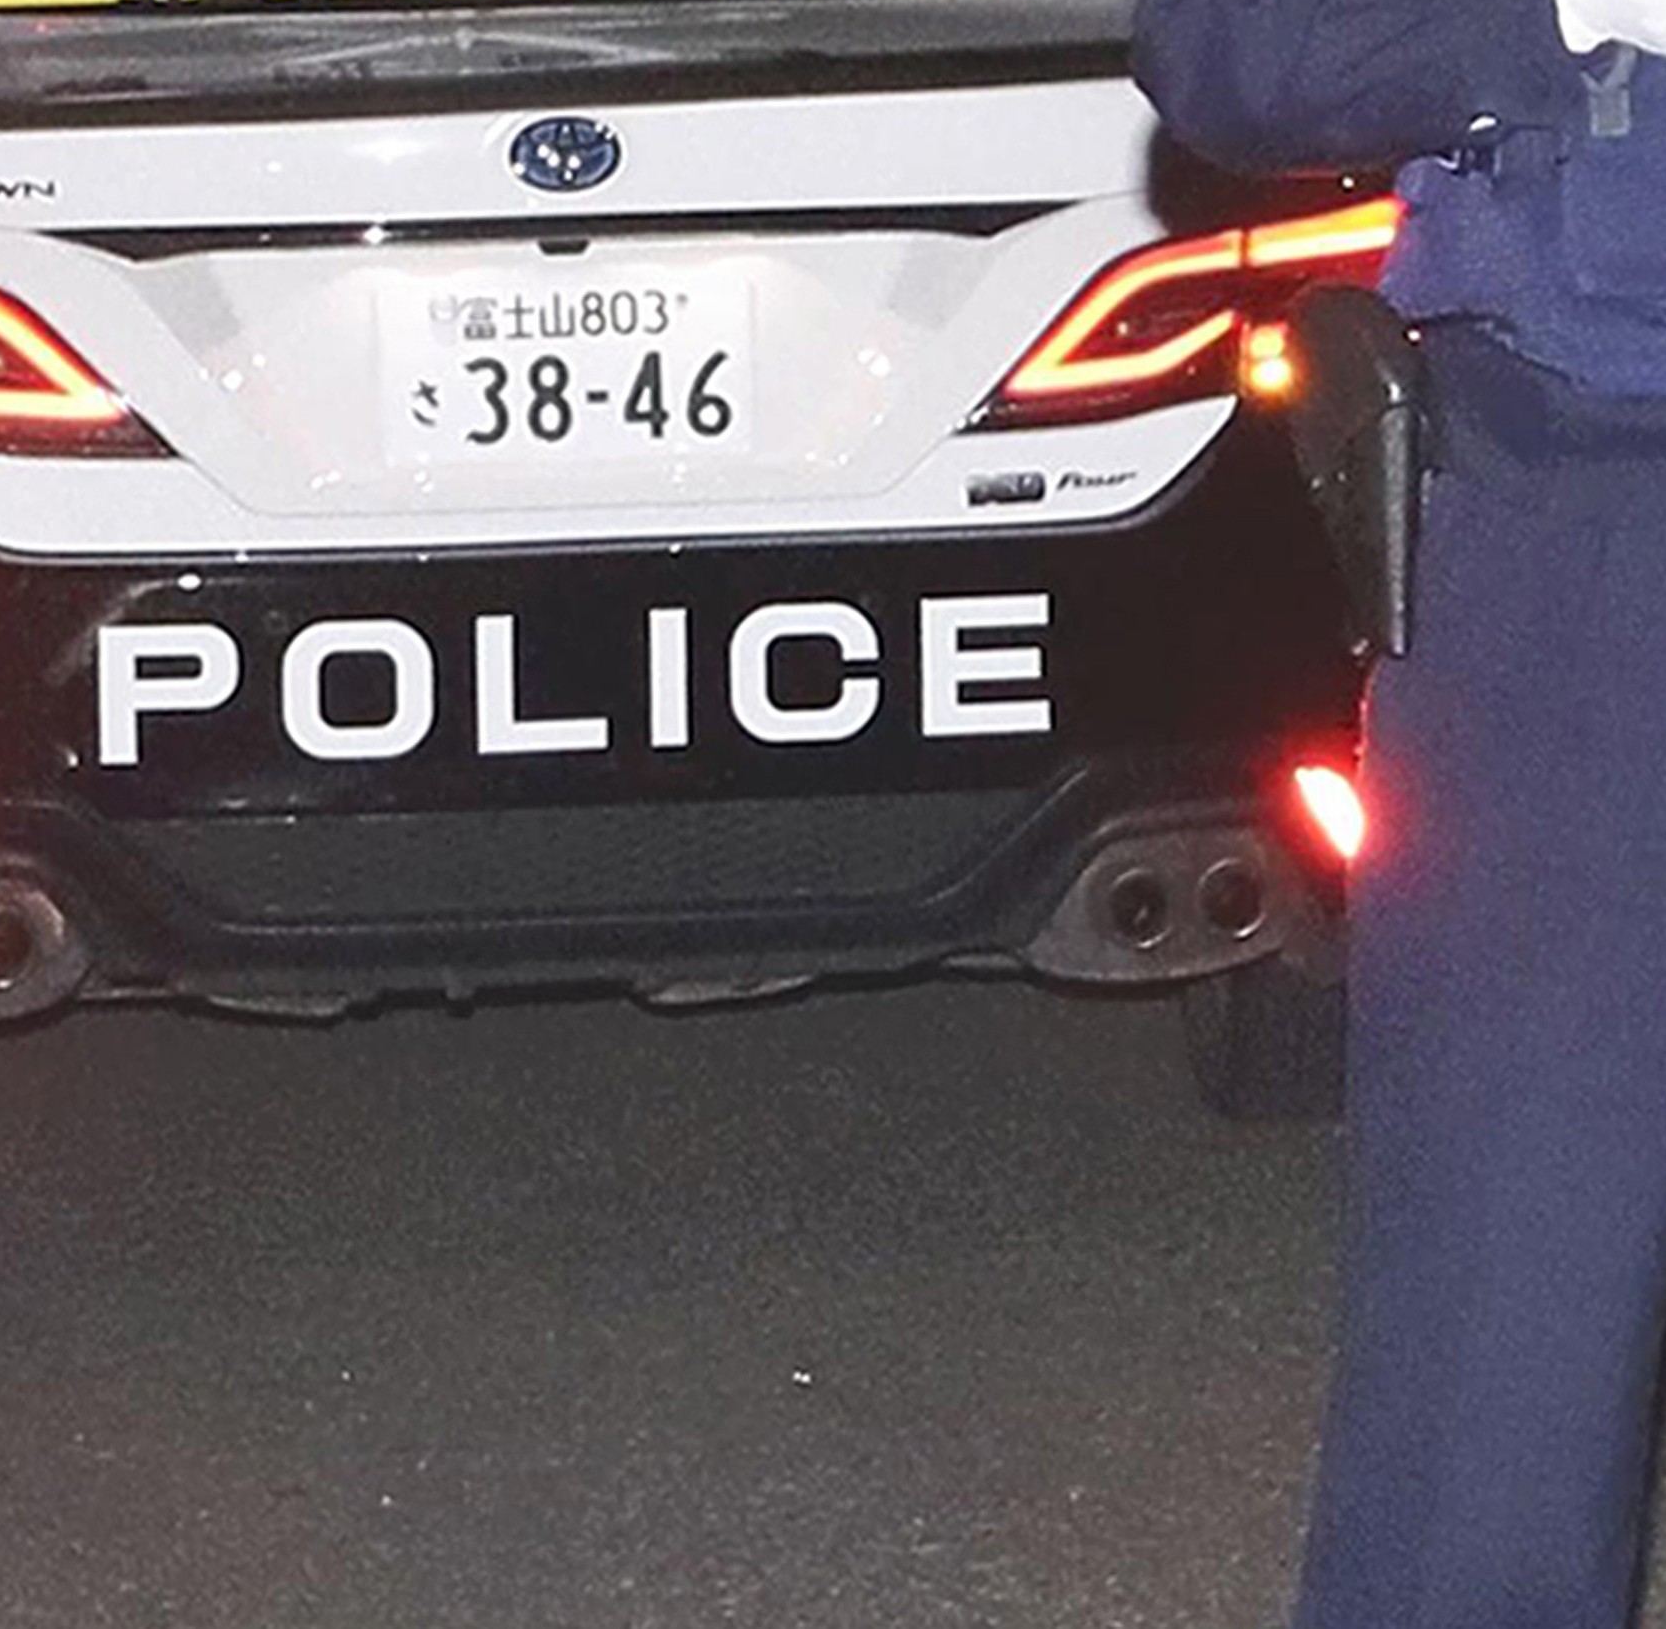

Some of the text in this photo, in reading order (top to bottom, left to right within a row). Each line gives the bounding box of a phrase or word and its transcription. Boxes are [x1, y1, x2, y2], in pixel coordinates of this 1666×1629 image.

[411, 349, 732, 445] さ 38-46
[97, 593, 1057, 768] POLICE
